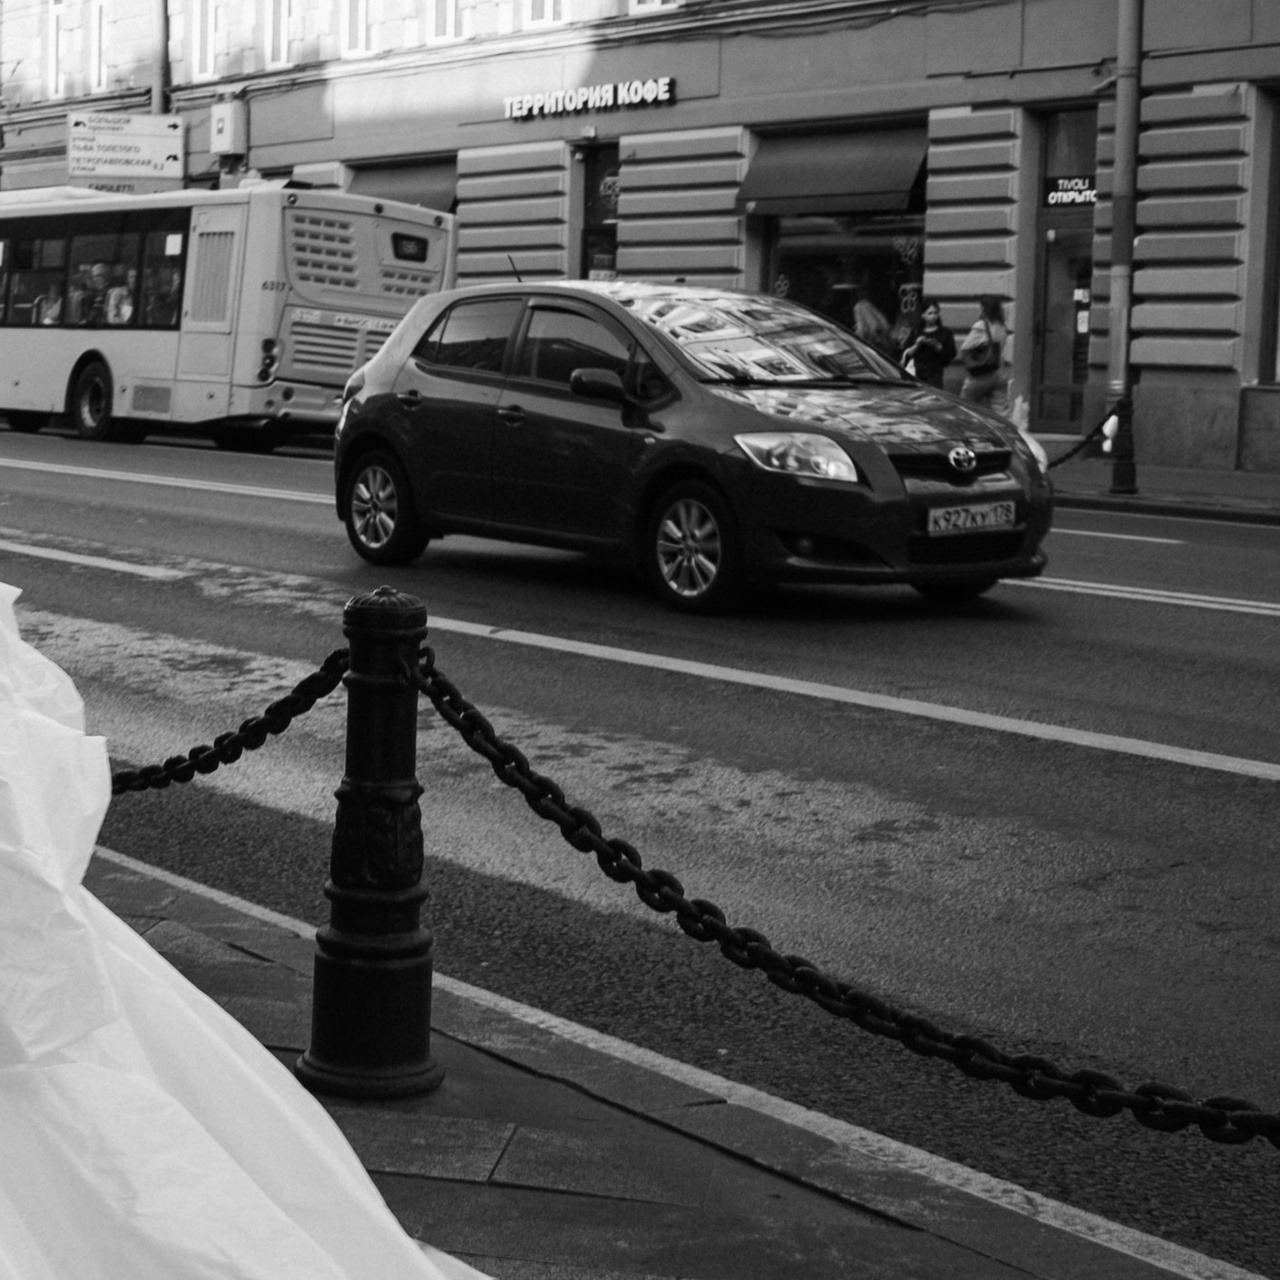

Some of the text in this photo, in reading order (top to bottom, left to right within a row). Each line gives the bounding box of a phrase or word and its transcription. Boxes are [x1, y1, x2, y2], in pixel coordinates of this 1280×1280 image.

[504, 76, 670, 119] ТЕРРИТОРИЯ КОФЕ
[1057, 178, 1089, 190] TIVOLI
